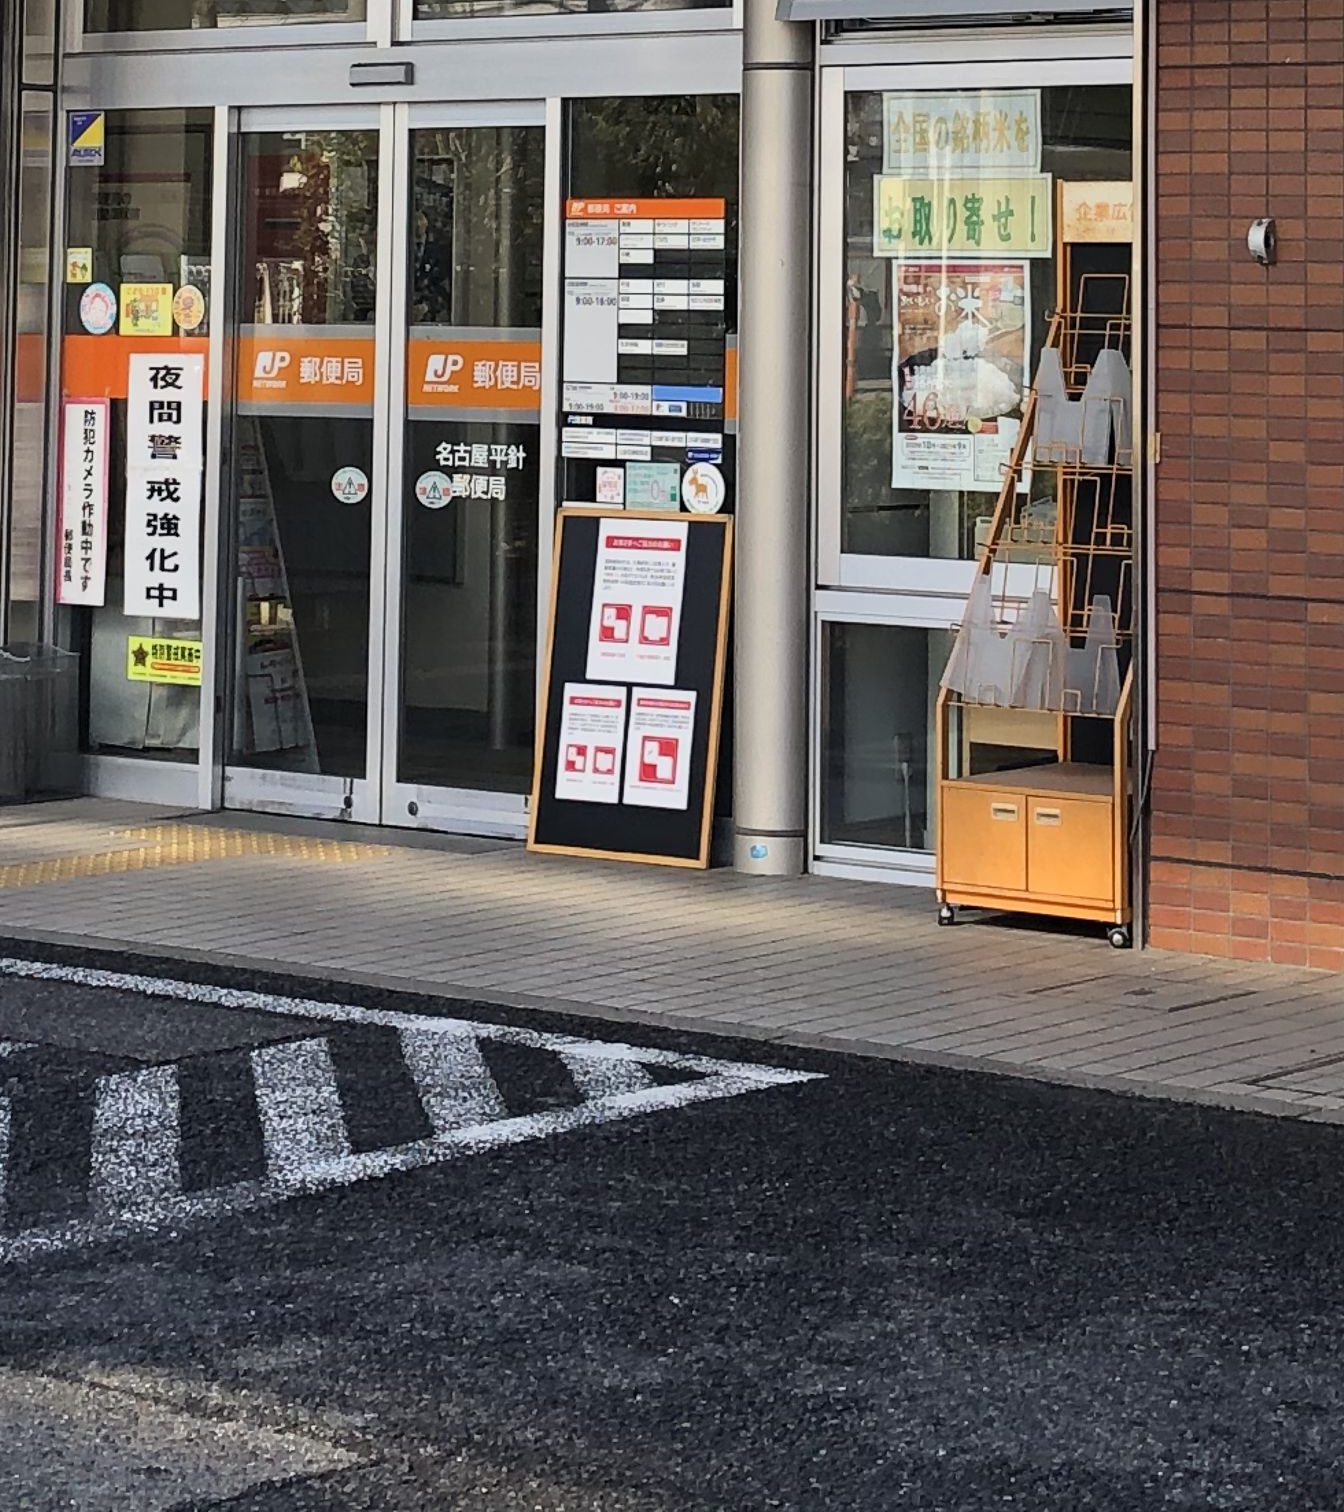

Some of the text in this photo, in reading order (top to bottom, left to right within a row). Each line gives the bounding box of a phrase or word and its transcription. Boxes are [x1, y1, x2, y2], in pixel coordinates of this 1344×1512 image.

[1076, 201, 1133, 222] 企業広
[299, 356, 363, 386] 郵便局
[473, 359, 541, 390] 郵便局
[435, 441, 527, 470] 名古屋平針
[80, 409, 97, 593] 防犯カメラ作動中です
[145, 365, 184, 609] 夜間警戒強化中
[451, 474, 506, 501] 郵便局
